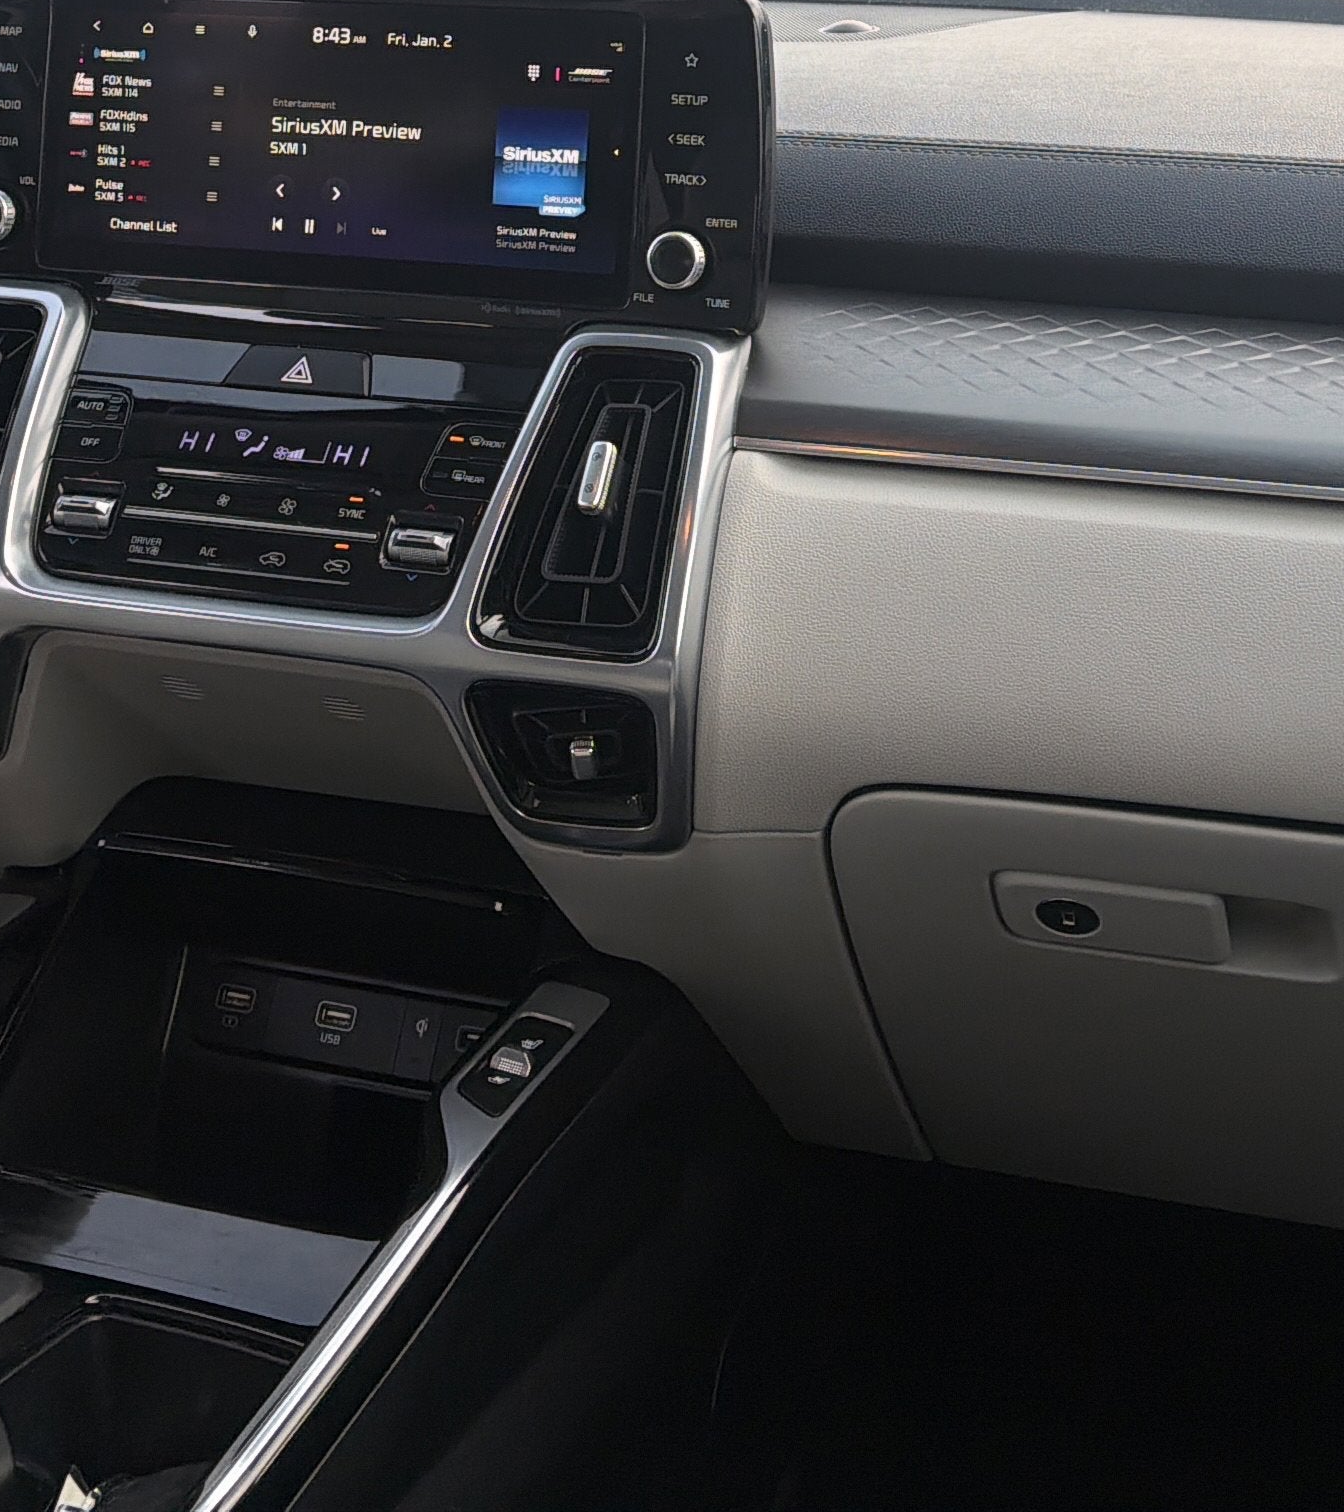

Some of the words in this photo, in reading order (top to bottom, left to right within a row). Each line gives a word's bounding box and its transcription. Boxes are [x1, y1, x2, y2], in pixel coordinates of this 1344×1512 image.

[0, 25, 23, 37] MAP
[312, 27, 351, 44] 8:43
[352, 35, 367, 44] AM
[412, 35, 440, 48] Jan.
[443, 35, 453, 48] 2
[102, 74, 123, 86] FOX
[125, 75, 152, 88] News
[101, 86, 123, 98] SXM
[125, 88, 138, 98] 114
[272, 97, 337, 110] Entertainment
[671, 94, 708, 106] SETUP
[99, 121, 122, 133] SXM
[123, 122, 136, 134] 115
[271, 116, 347, 136] SiriusXM
[352, 120, 422, 141] Preview
[676, 133, 705, 147] SEEK
[97, 144, 118, 155] Hits
[270, 141, 299, 155] SXM
[302, 142, 307, 156] 1
[502, 146, 580, 165] SiriusXM
[96, 156, 117, 167] SXM
[119, 157, 126, 168] 2
[19, 175, 36, 186] VOL
[95, 178, 124, 191] Pulse
[665, 172, 699, 185] TRACK
[94, 191, 116, 202] SXM
[117, 192, 124, 203] 5
[109, 217, 154, 231] Channel
[156, 220, 178, 233] List
[706, 217, 738, 229] ENTER
[496, 225, 537, 237] SiriusXM
[538, 228, 577, 240] Preview
[495, 239, 537, 250] SiriusXM
[538, 241, 576, 253] Preview
[633, 292, 655, 303] FILE
[705, 297, 730, 309] TUNE
[76, 400, 105, 412] AUTO
[80, 437, 100, 447] OFF
[481, 439, 506, 449] FRONT
[463, 474, 485, 484] REAR
[337, 507, 367, 520] SYNC
[130, 535, 163, 545] DRIVER
[128, 544, 152, 555] ONLY
[199, 546, 218, 558] A/C
[319, 1032, 341, 1045] USB
